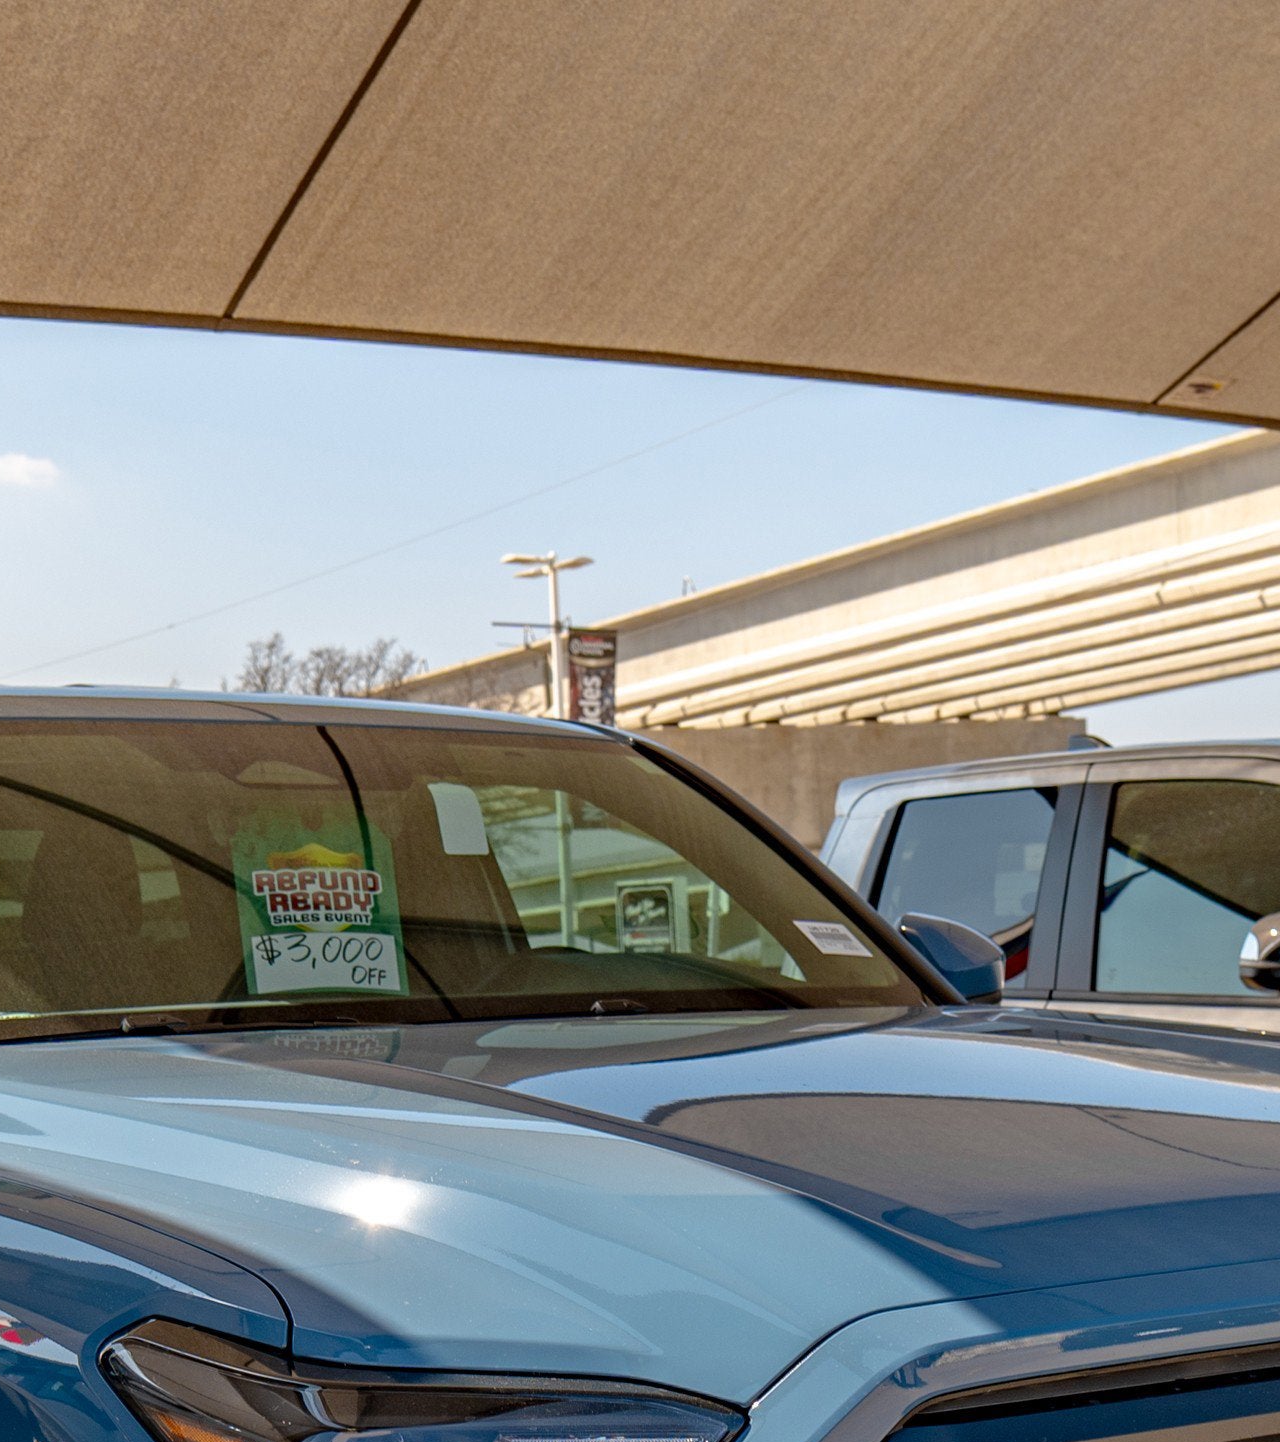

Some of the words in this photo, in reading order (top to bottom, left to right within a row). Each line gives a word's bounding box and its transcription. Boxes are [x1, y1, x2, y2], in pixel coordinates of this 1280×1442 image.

[254, 870, 380, 893] REFUND
[270, 892, 373, 913] READY
[273, 913, 320, 924] SALES
[325, 912, 371, 924] EVENT
[256, 934, 383, 969] $3,000
[352, 965, 387, 985] OFF
